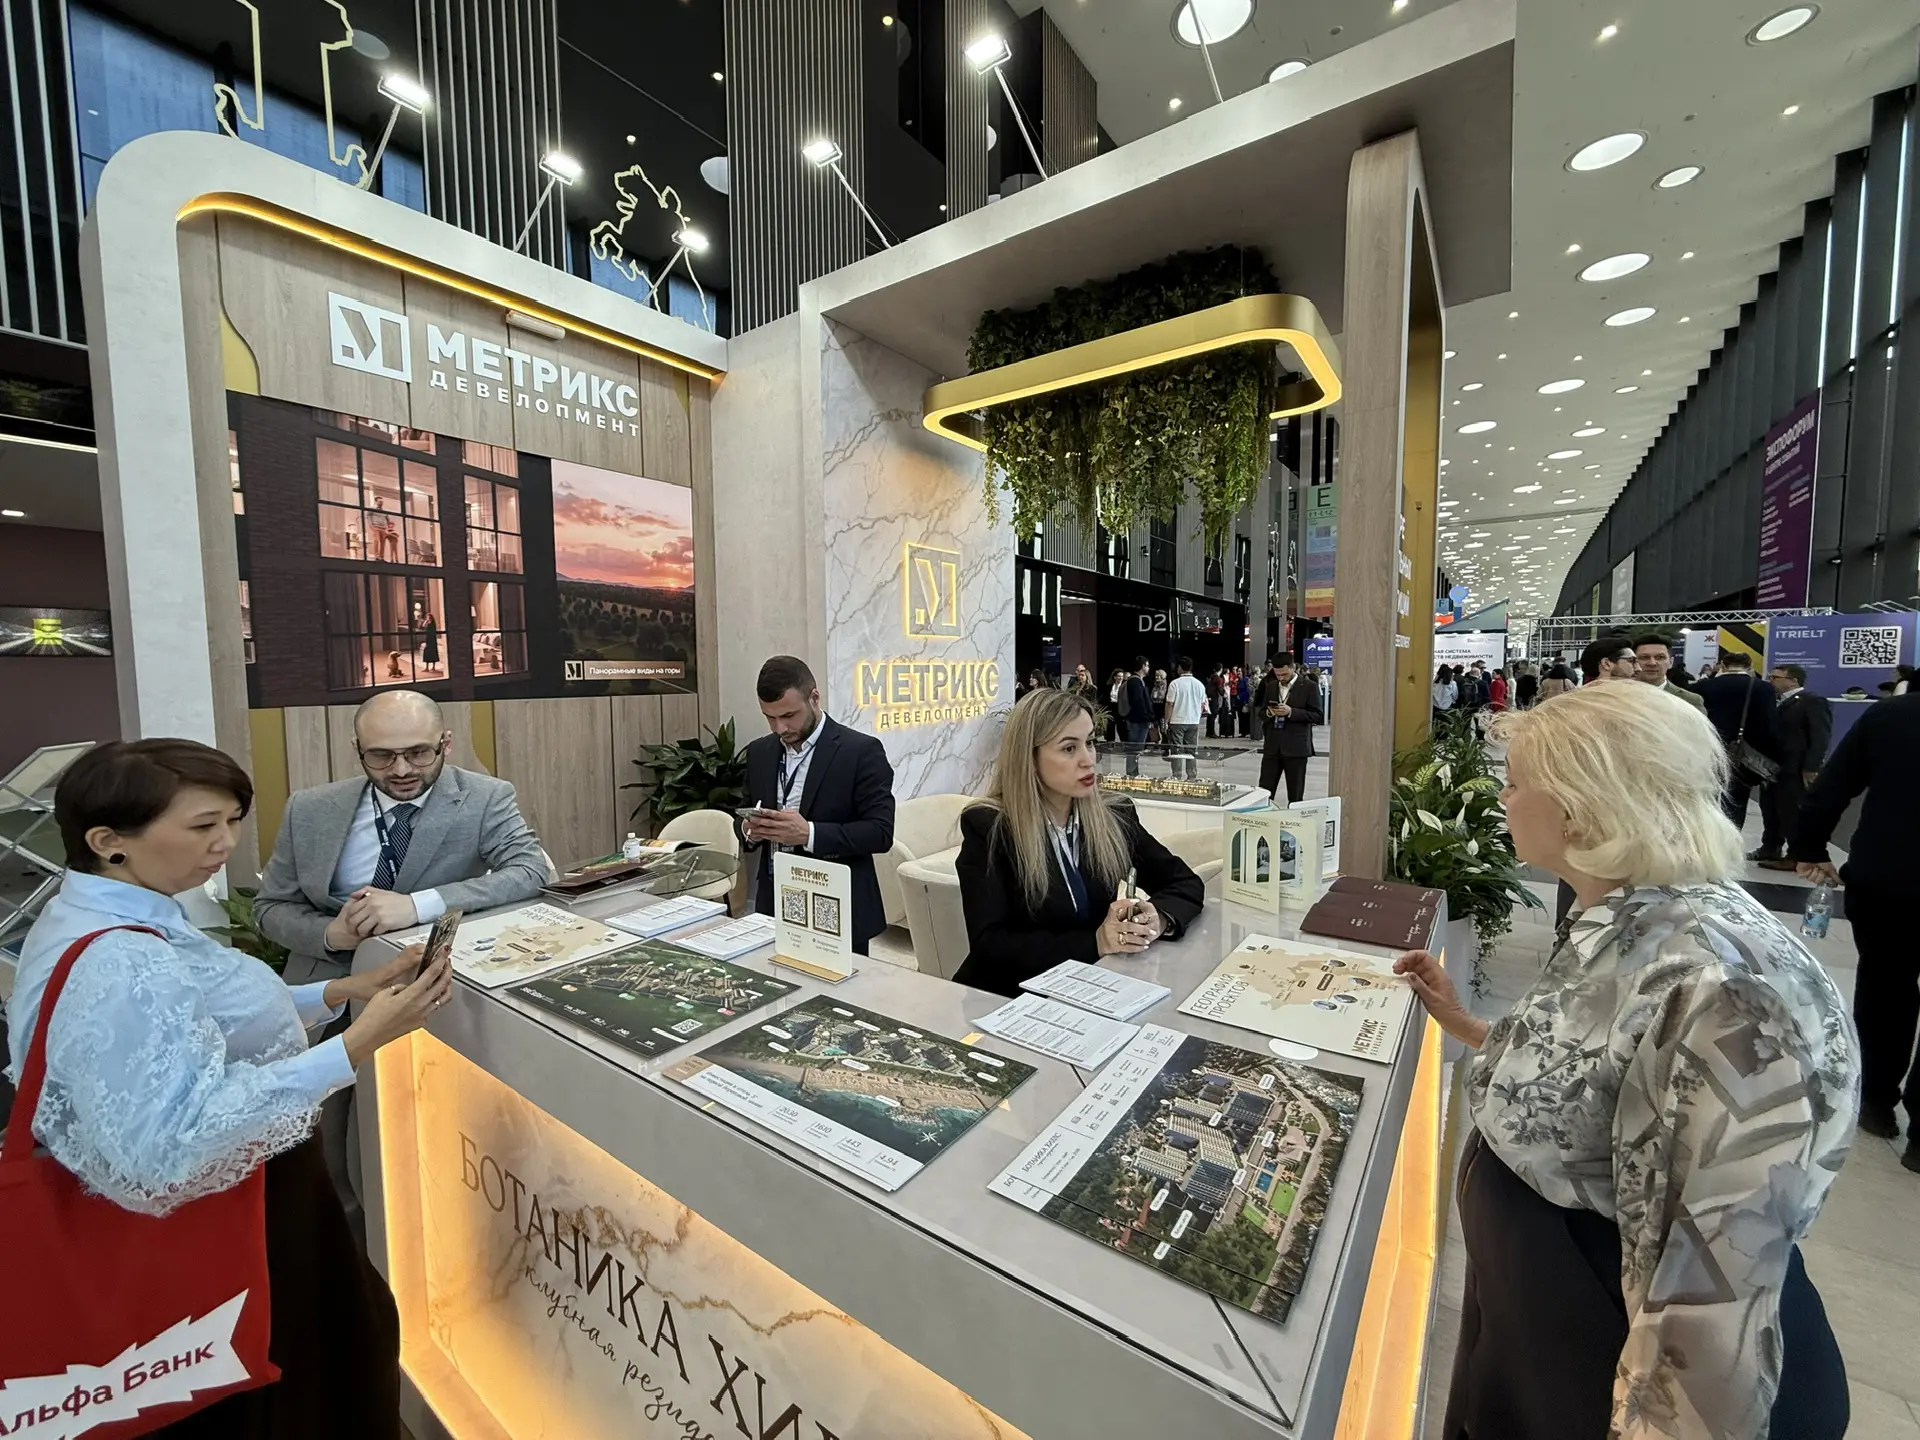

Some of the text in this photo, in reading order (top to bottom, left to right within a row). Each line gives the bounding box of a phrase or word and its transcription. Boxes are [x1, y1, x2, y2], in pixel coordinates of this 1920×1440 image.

[427, 323, 640, 418] МЕТРИКС
[429, 369, 641, 437] ДЕВЕЛОПМЕНТ
[1317, 486, 1331, 507] E
[1139, 614, 1167, 632] D2
[1775, 629, 1827, 639] ITRIELT
[589, 667, 636, 675] Панорамные
[637, 667, 655, 675] виды
[665, 667, 681, 675] горы
[858, 659, 1000, 705] МЕТРИКС
[879, 705, 989, 729] ДЕВЕЛОПМЕНТ
[791, 866, 829, 882] МЕТРИКС
[1190, 973, 1235, 1013] ГЕОГРАФИЯ
[1208, 981, 1249, 1018] ПРОЕКТОВ
[1351, 1019, 1378, 1054] МЕТРИКС
[778, 1105, 799, 1118] 2030
[814, 1121, 833, 1134] 1610
[845, 1137, 862, 1148] 443
[1021, 1146, 1048, 1173] БОТАНИКА
[458, 1130, 842, 1440] БОТАНИКА ХИ
[524, 1263, 617, 1362] клубная
[123, 1341, 216, 1393] Банк
